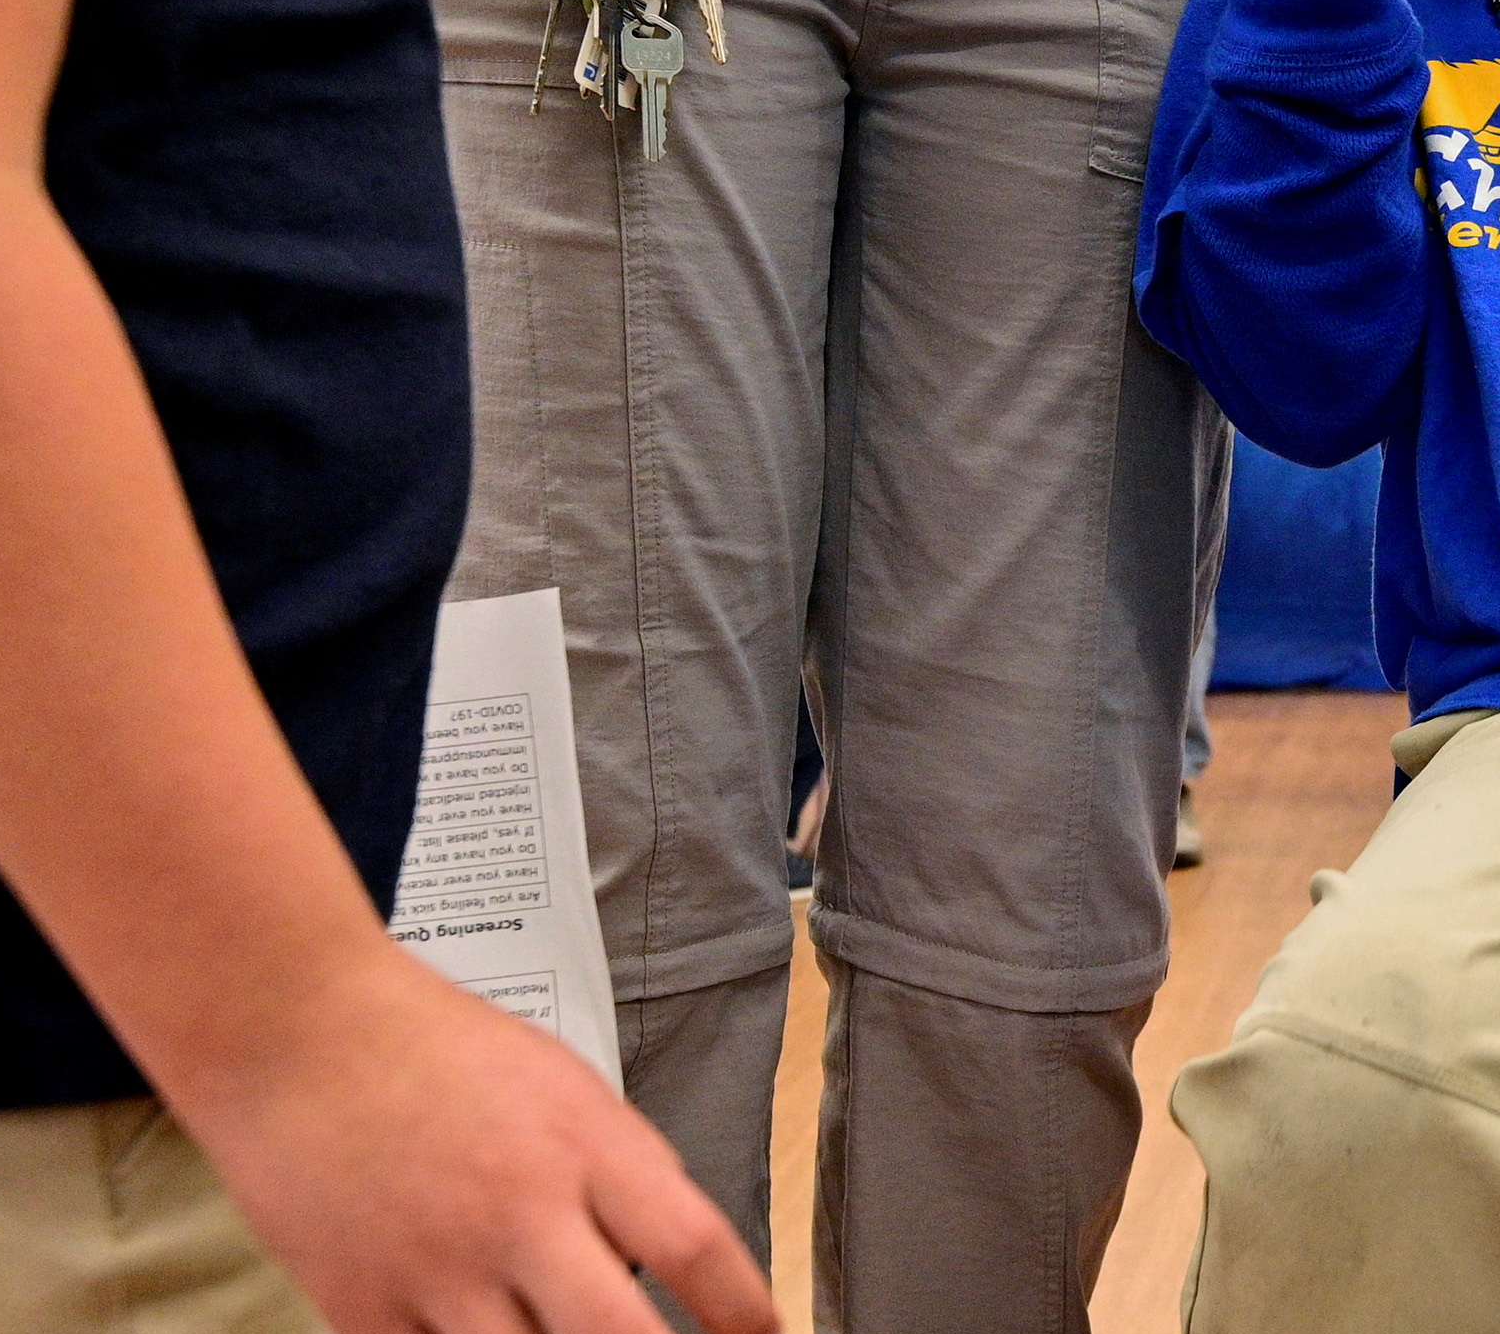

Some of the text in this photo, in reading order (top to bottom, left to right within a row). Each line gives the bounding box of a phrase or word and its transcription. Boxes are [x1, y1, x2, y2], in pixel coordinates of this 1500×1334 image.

[449, 703, 523, 722] COVID-19?
[426, 721, 524, 741] Have you been
[482, 763, 506, 775] you
[510, 762, 528, 773] Do
[446, 768, 478, 781] have
[478, 784, 531, 801] injected
[470, 805, 496, 817] you
[500, 802, 532, 815] Have
[438, 811, 467, 823] ever
[446, 829, 490, 844] please
[454, 849, 486, 862] have
[490, 843, 514, 855] you
[518, 843, 536, 855] Do
[425, 853, 449, 865] any
[476, 868, 500, 882] you
[505, 866, 538, 879] Have
[443, 874, 472, 886] ever
[440, 895, 486, 911] feeling
[489, 891, 514, 905] you
[518, 891, 541, 903] Are
[410, 903, 436, 915] sick
[436, 918, 524, 938] Screening
